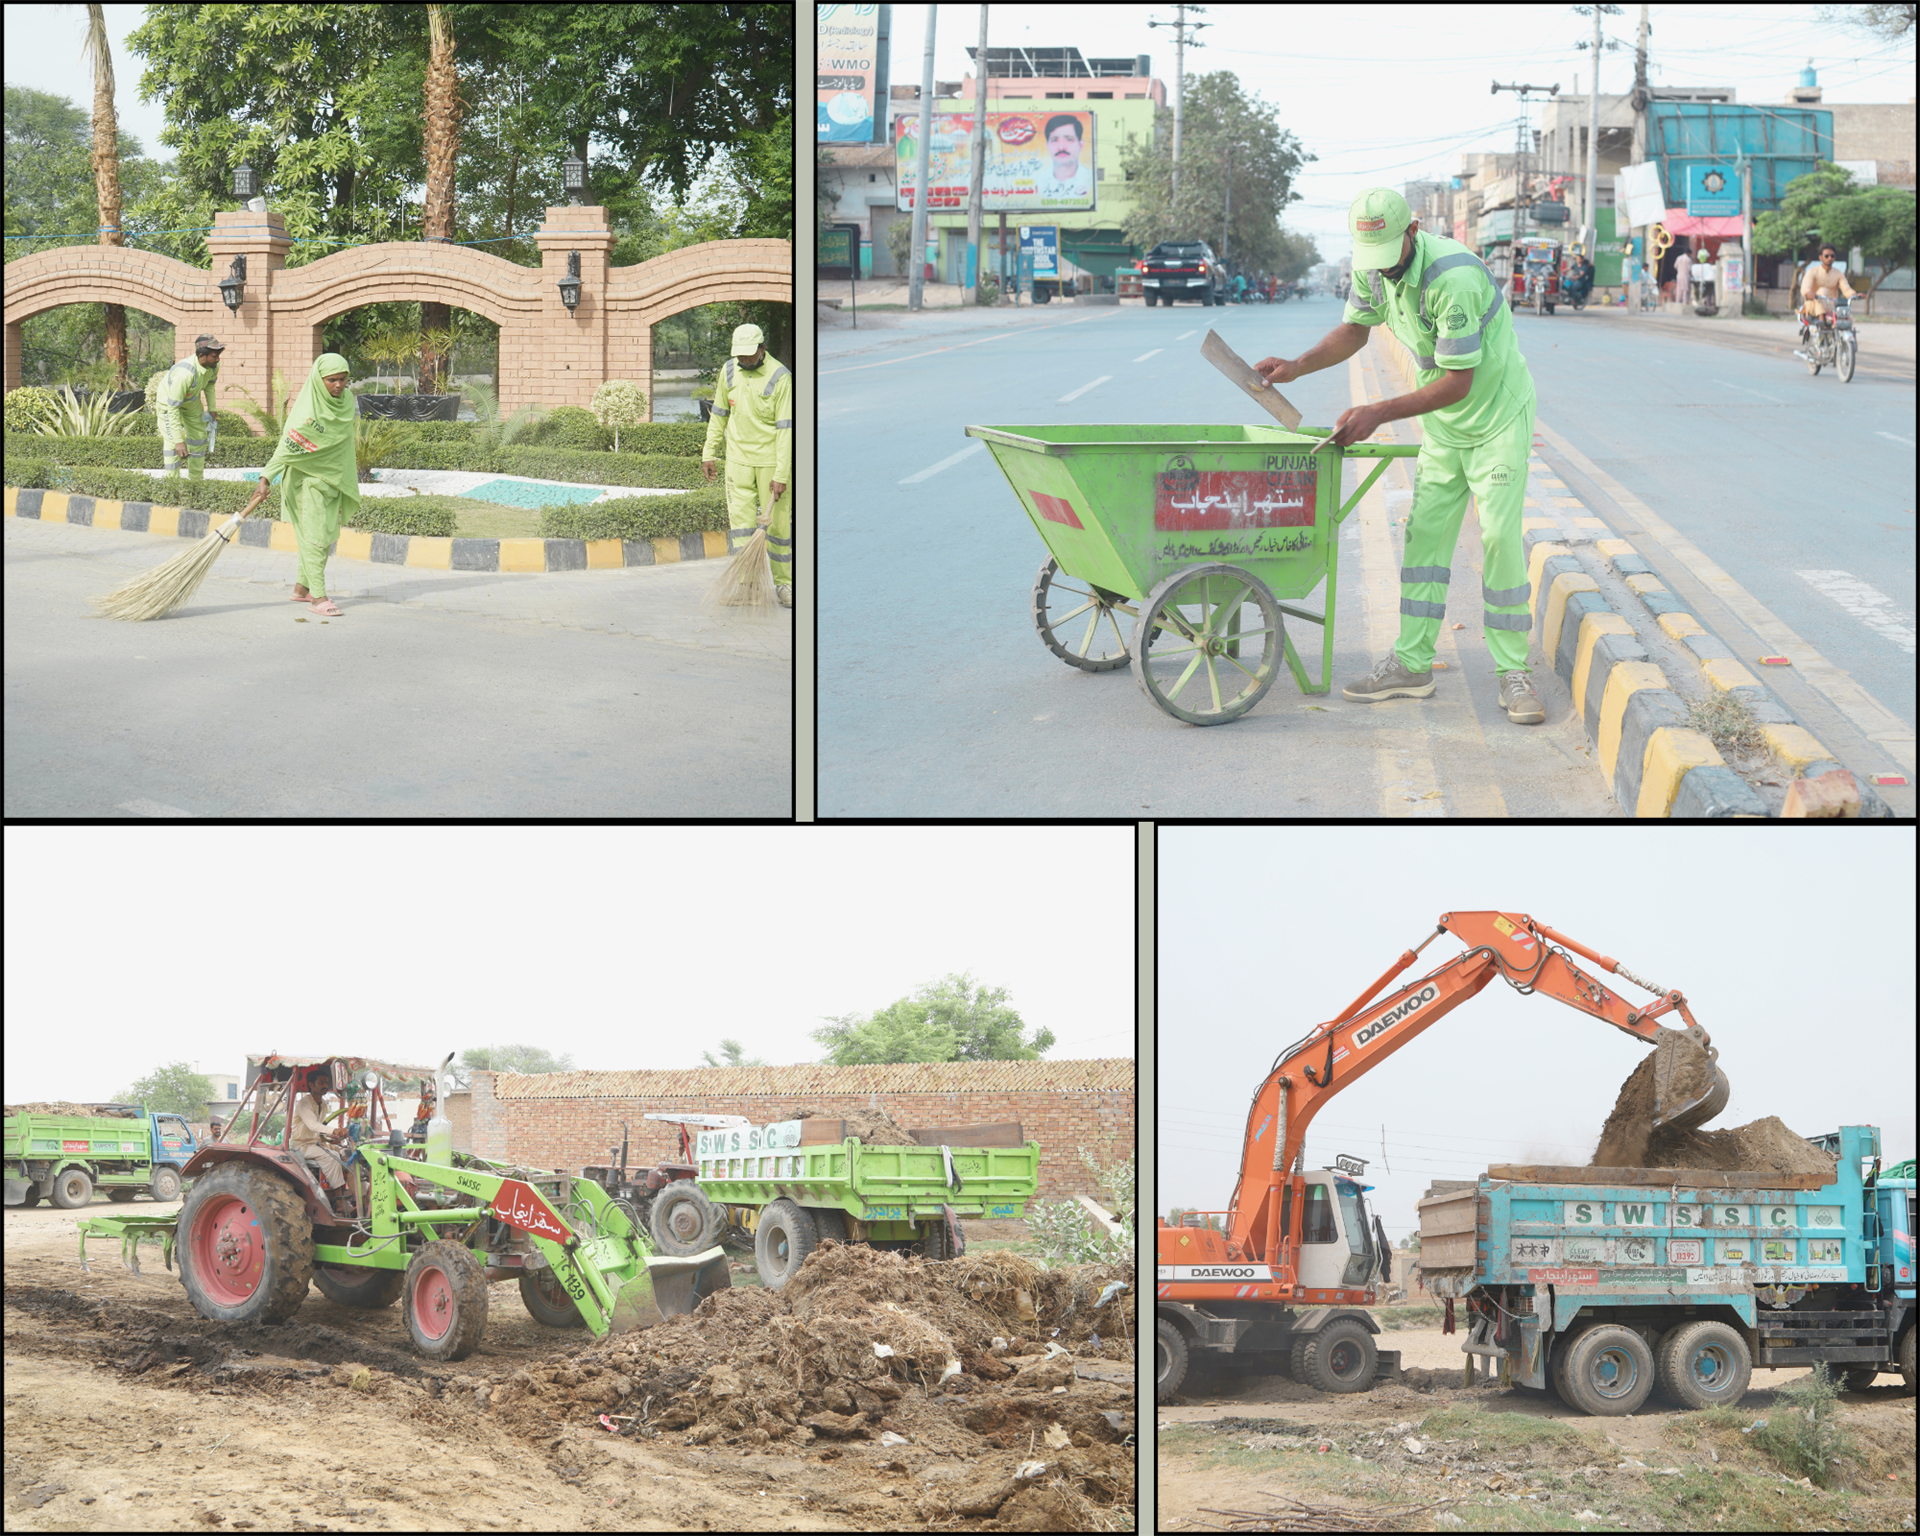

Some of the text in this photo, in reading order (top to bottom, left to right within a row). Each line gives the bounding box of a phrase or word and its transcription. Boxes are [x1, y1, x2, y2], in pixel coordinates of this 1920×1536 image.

[831, 59, 871, 70] WMO
[1266, 455, 1318, 470] PUNJAB
[1266, 471, 1315, 487] CLEAN
[1171, 490, 1243, 516] پنجاب
[1356, 986, 1435, 1045] DAEWOO
[456, 1175, 482, 1192] SWSSC
[1676, 1252, 1691, 1261] 1139
[1190, 1268, 1255, 1278] DAEWOO
[564, 1272, 586, 1302] 1139
